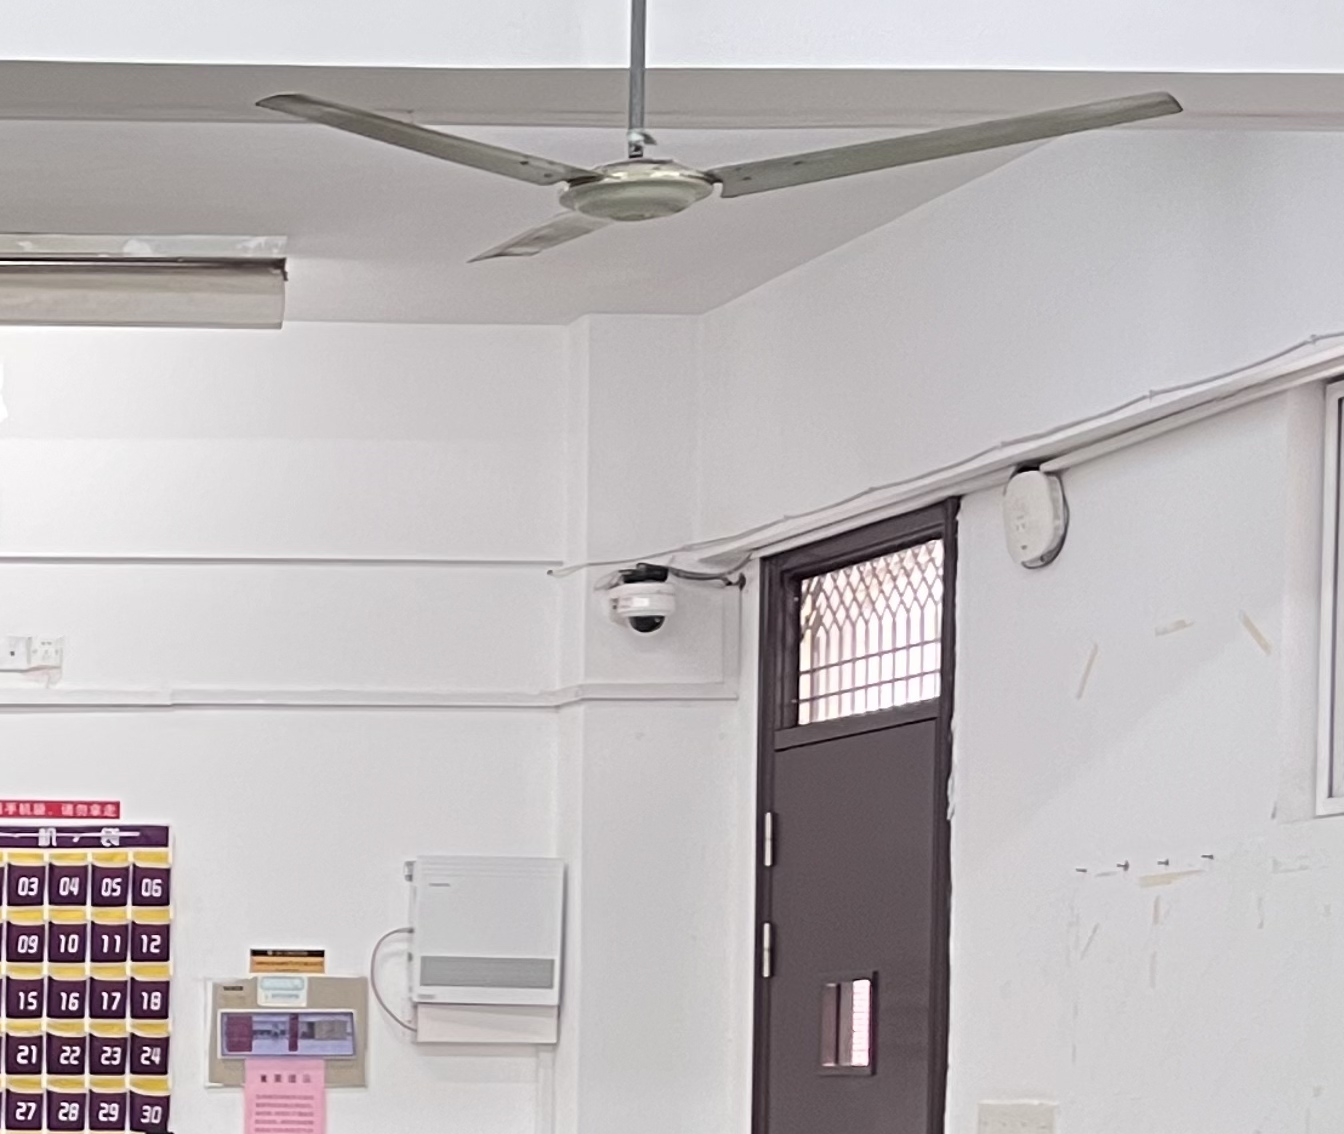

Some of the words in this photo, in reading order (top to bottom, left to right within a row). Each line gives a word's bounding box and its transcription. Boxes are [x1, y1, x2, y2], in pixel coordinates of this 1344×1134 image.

[18, 877, 38, 895] 03
[60, 877, 79, 895] 04
[102, 878, 121, 896] 05
[142, 879, 161, 896] 06
[18, 935, 38, 953] 09
[60, 935, 78, 952] 10
[102, 935, 120, 952] 11
[142, 935, 160, 953] 12
[19, 992, 37, 1010] 15
[61, 992, 79, 1010] 16
[102, 992, 121, 1010] 17
[142, 992, 161, 1010] 18
[17, 1045, 36, 1064] 21
[60, 1046, 80, 1064] 22
[101, 1047, 121, 1065] 23
[141, 1047, 160, 1064] 24
[16, 1102, 36, 1120] 27
[59, 1102, 79, 1121] 28
[99, 1103, 119, 1121] 29
[141, 1106, 161, 1123] 30
